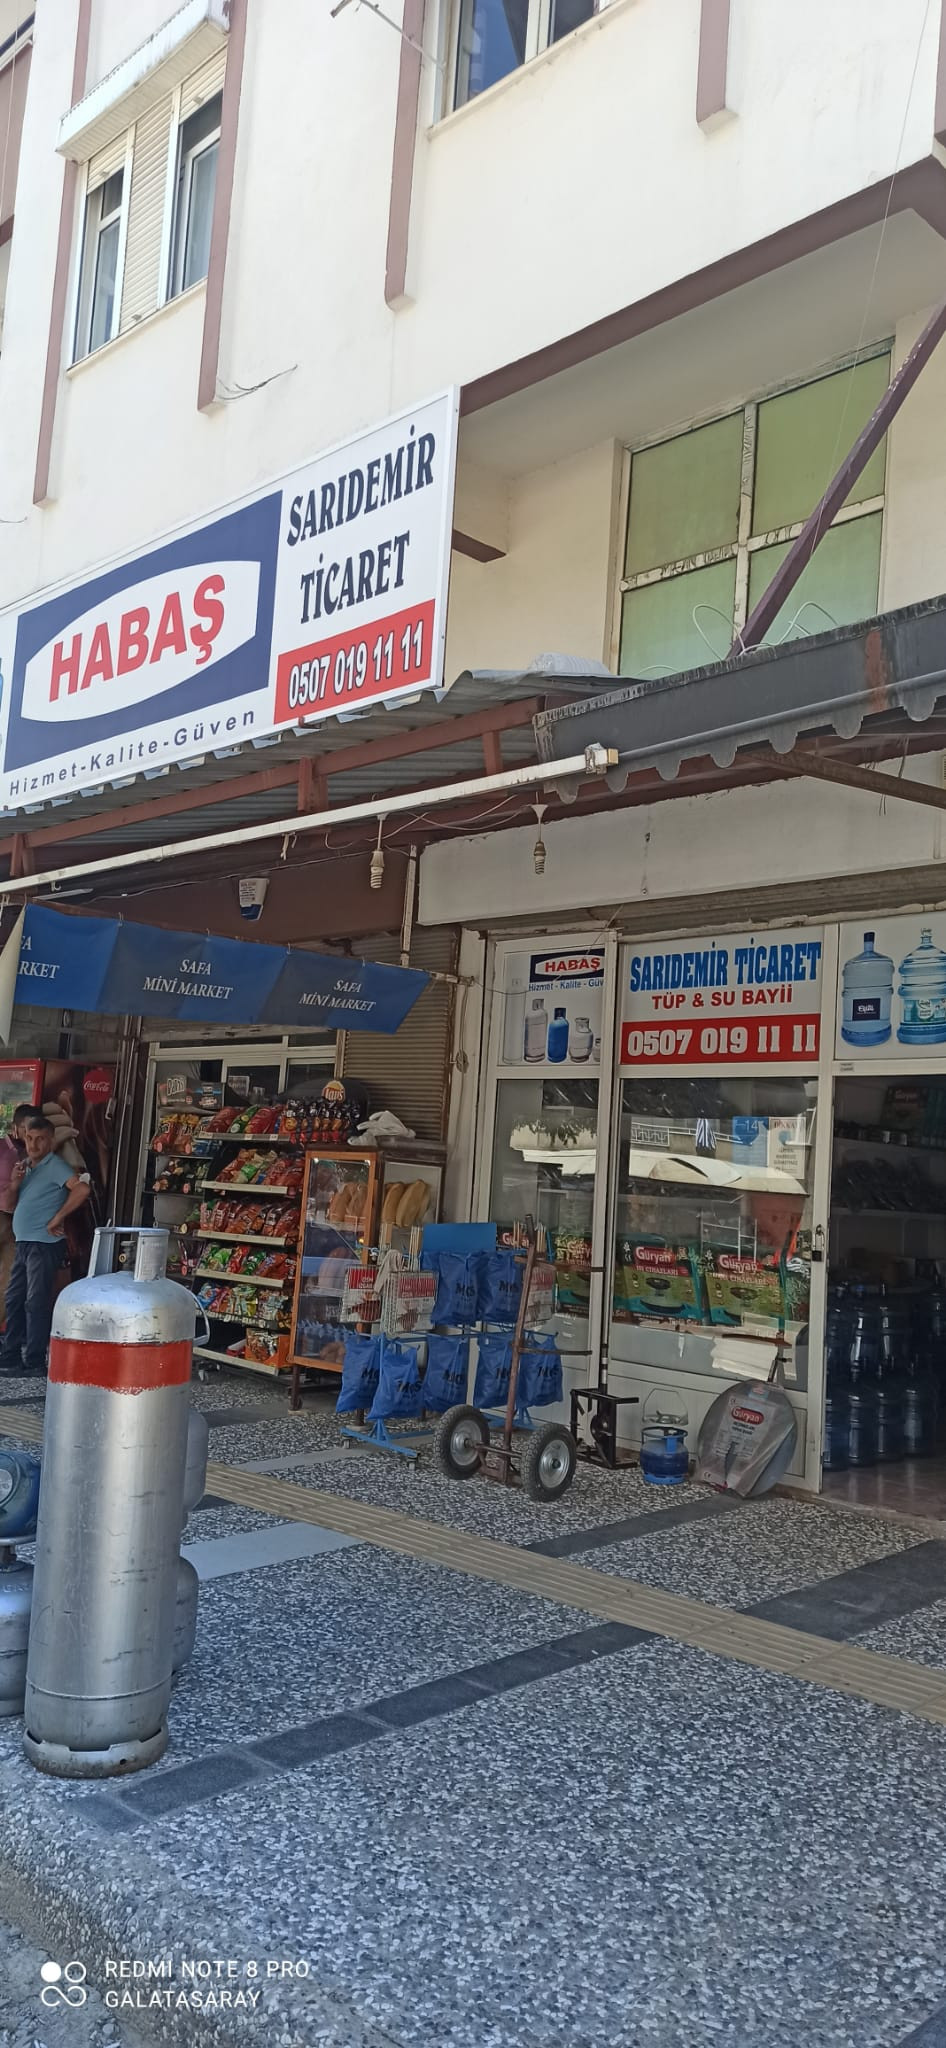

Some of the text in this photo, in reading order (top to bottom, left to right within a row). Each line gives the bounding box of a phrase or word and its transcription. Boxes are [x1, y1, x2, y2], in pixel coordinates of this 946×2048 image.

[287, 424, 436, 546] SARIDEMİR
[300, 531, 410, 625] TİCARET
[49, 574, 226, 703] HABAŞ
[289, 619, 424, 709] 0507 019 11 11
[179, 959, 212, 976] SAFA
[544, 957, 601, 973] HABAŞ
[630, 937, 822, 993] SARIDEMİR TİCARET
[143, 975, 234, 1000] MİNİ MARKET
[333, 979, 362, 993] SAFA
[528, 983, 554, 992] Hizmet
[560, 980, 582, 990] Kalite
[652, 984, 793, 1010] TÜP & SU BAYİİ
[299, 991, 377, 1012] MİNİ MARKET
[628, 1024, 816, 1057] 0507 019 11 11
